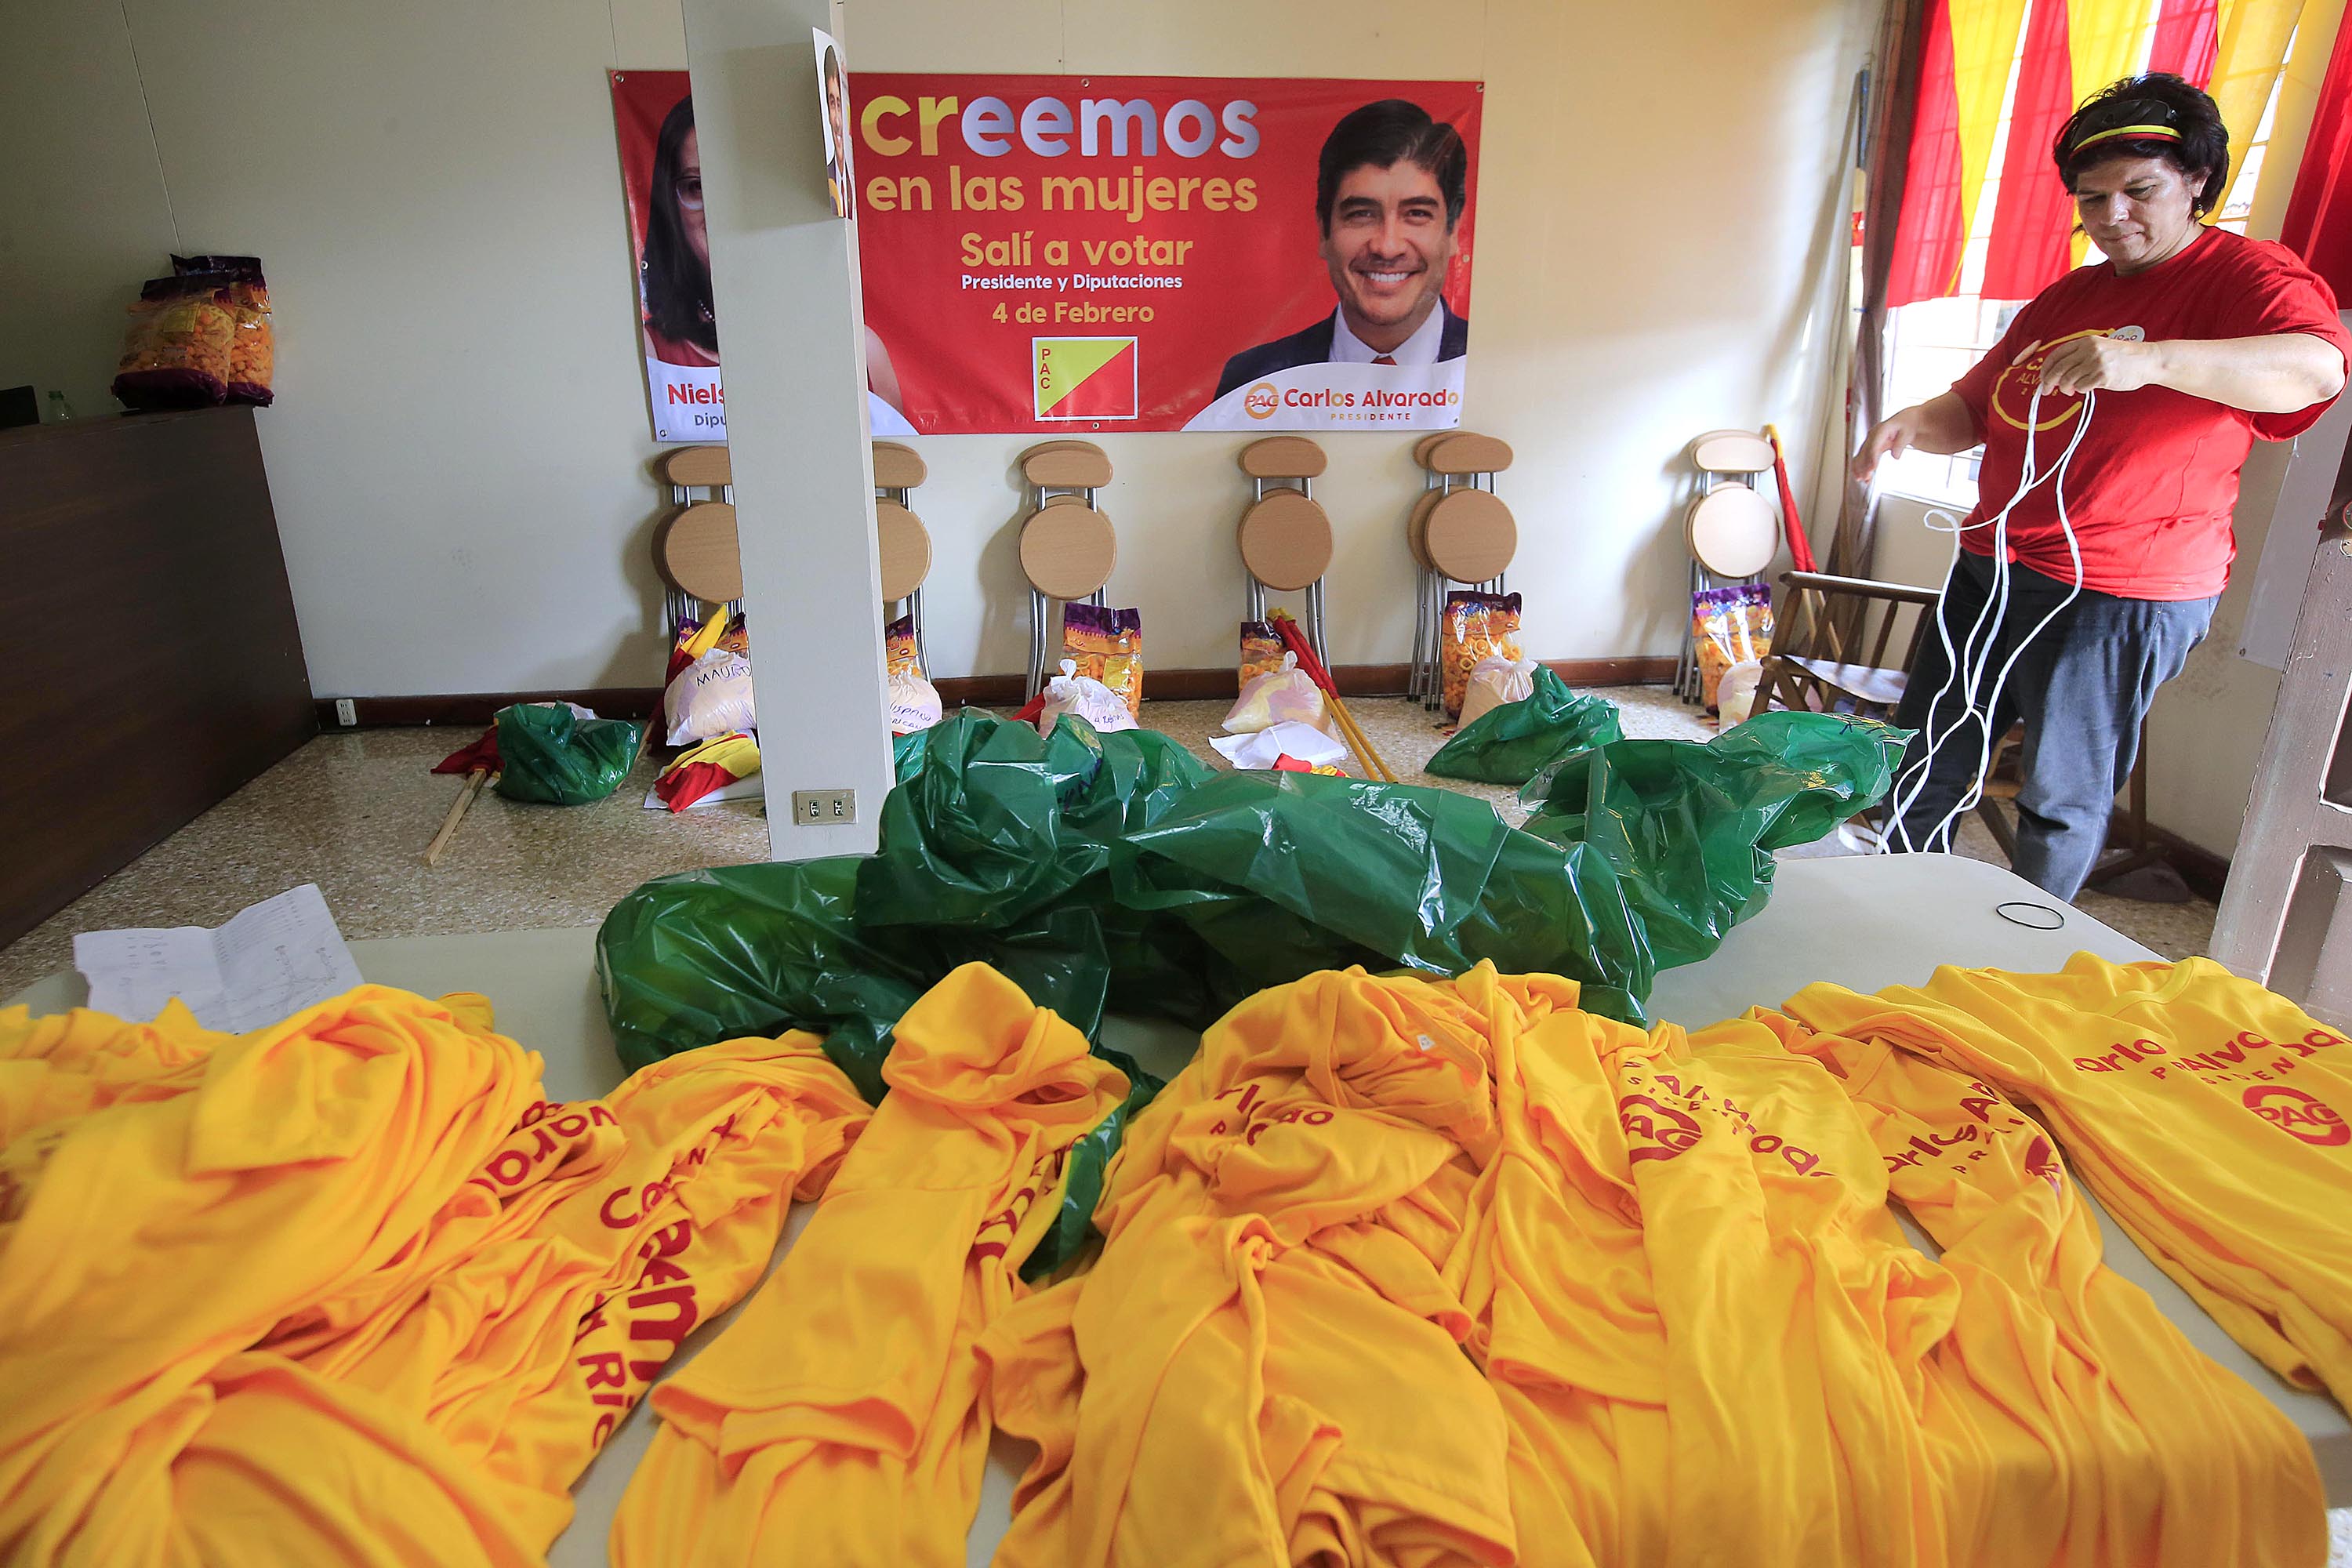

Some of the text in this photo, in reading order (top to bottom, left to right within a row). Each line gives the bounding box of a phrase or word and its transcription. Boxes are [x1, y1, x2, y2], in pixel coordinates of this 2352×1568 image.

[861, 96, 1261, 159] creemos
[866, 165, 1258, 223] en las mujeres
[960, 230, 1194, 267] Salí a votar
[961, 273, 1183, 292] Presidente y Diputaciones
[992, 301, 1155, 323] 4 de Febrero
[1040, 348, 1051, 389] PAC
[1284, 389, 1459, 407] Carlos Alvarado
[1330, 412, 1410, 421] PRESIDENTE
